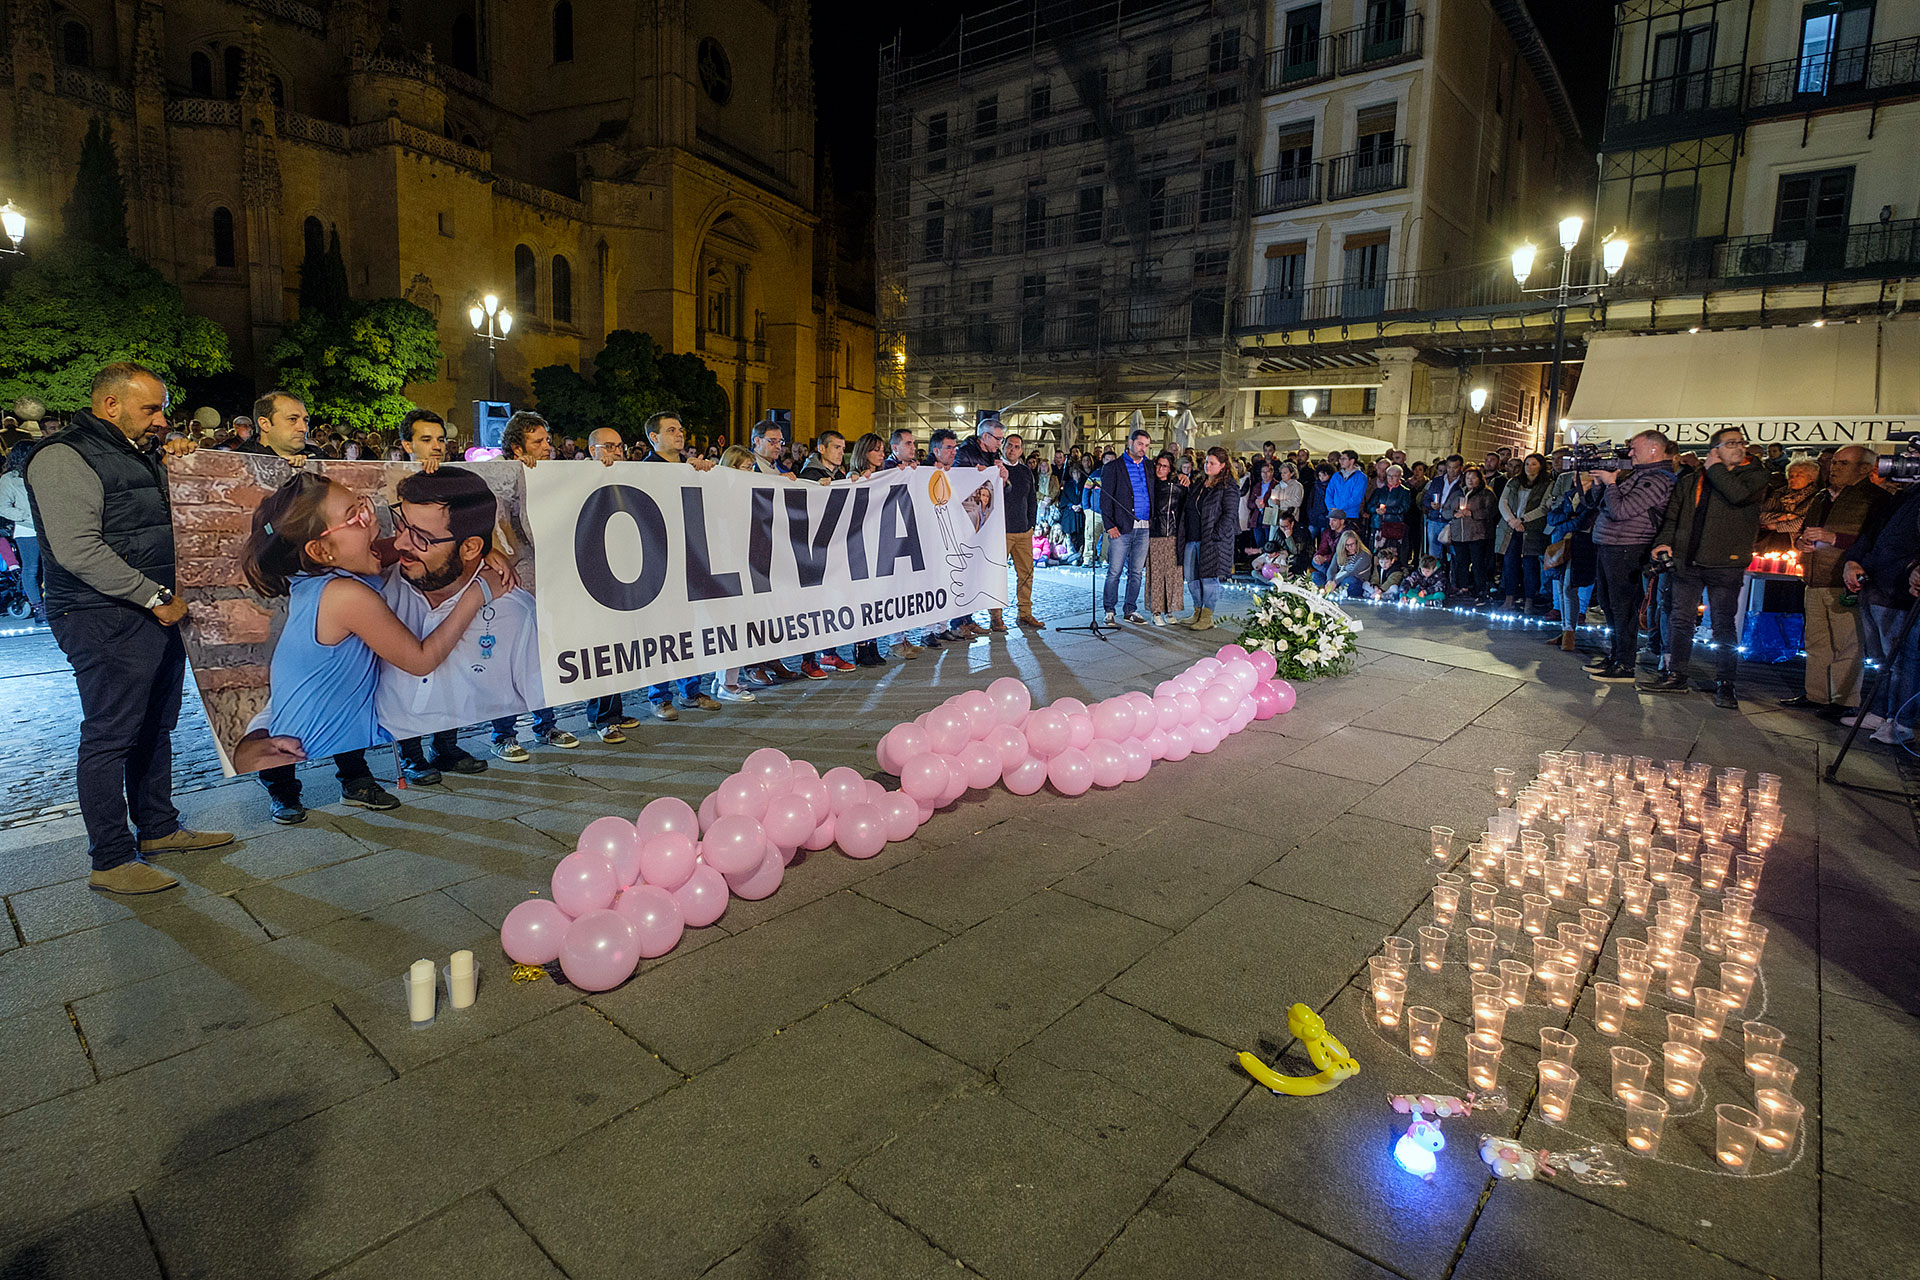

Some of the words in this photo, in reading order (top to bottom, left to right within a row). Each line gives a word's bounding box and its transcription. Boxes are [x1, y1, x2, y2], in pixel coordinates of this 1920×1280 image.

[574, 484, 926, 611] OLIVIA
[557, 631, 694, 684] SIEMPRE
[702, 624, 736, 656] EN
[746, 606, 855, 648] NUESTRO
[861, 588, 948, 625] RECUERDO
